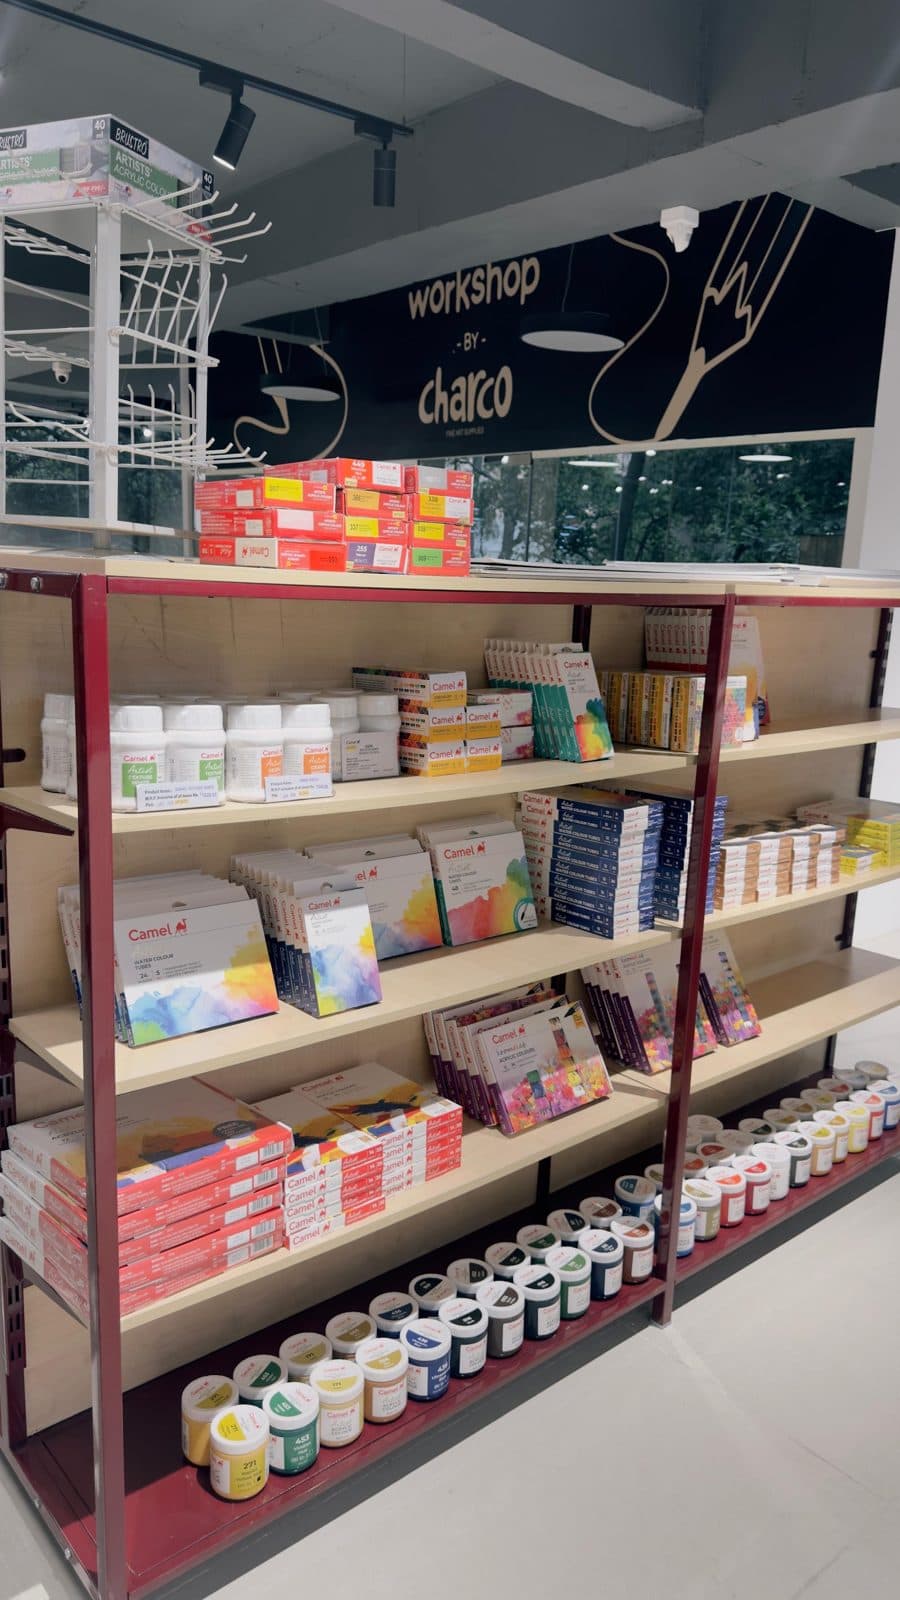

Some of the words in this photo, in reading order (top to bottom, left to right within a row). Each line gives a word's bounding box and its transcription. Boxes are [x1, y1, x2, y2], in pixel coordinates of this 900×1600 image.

[94, 119, 106, 130] 40
[0, 133, 25, 150] RUSTRO
[115, 127, 149, 156] BRUSTRO
[113, 164, 145, 187] ACRYLIC
[203, 172, 213, 184] 40
[408, 256, 541, 320] workshop
[464, 332, 479, 350] BY
[418, 365, 513, 425] charco
[564, 660, 583, 669] Camel
[432, 681, 456, 691] Camel
[431, 715, 455, 724] Camel
[468, 712, 491, 721] Camel
[429, 750, 453, 759] Camel
[469, 746, 491, 754] Camel
[523, 794, 543, 803] Camel
[527, 805, 545, 814] Camel
[444, 845, 475, 859] Camel
[308, 899, 332, 910] Camel
[128, 922, 172, 941] Camel
[134, 957, 153, 965] WATER
[153, 953, 174, 961] COLOUR
[492, 1030, 517, 1044] Camel
[287, 1171, 316, 1189] Camel
[288, 1185, 317, 1203] Camel
[287, 1200, 315, 1217] Camel
[288, 1213, 317, 1231] Camel
[293, 1227, 320, 1245] Camel
[377, 1386, 400, 1396] Camel
[326, 1410, 349, 1418] Camel
[295, 1434, 310, 1445] 453
[243, 1459, 257, 1470] 271
